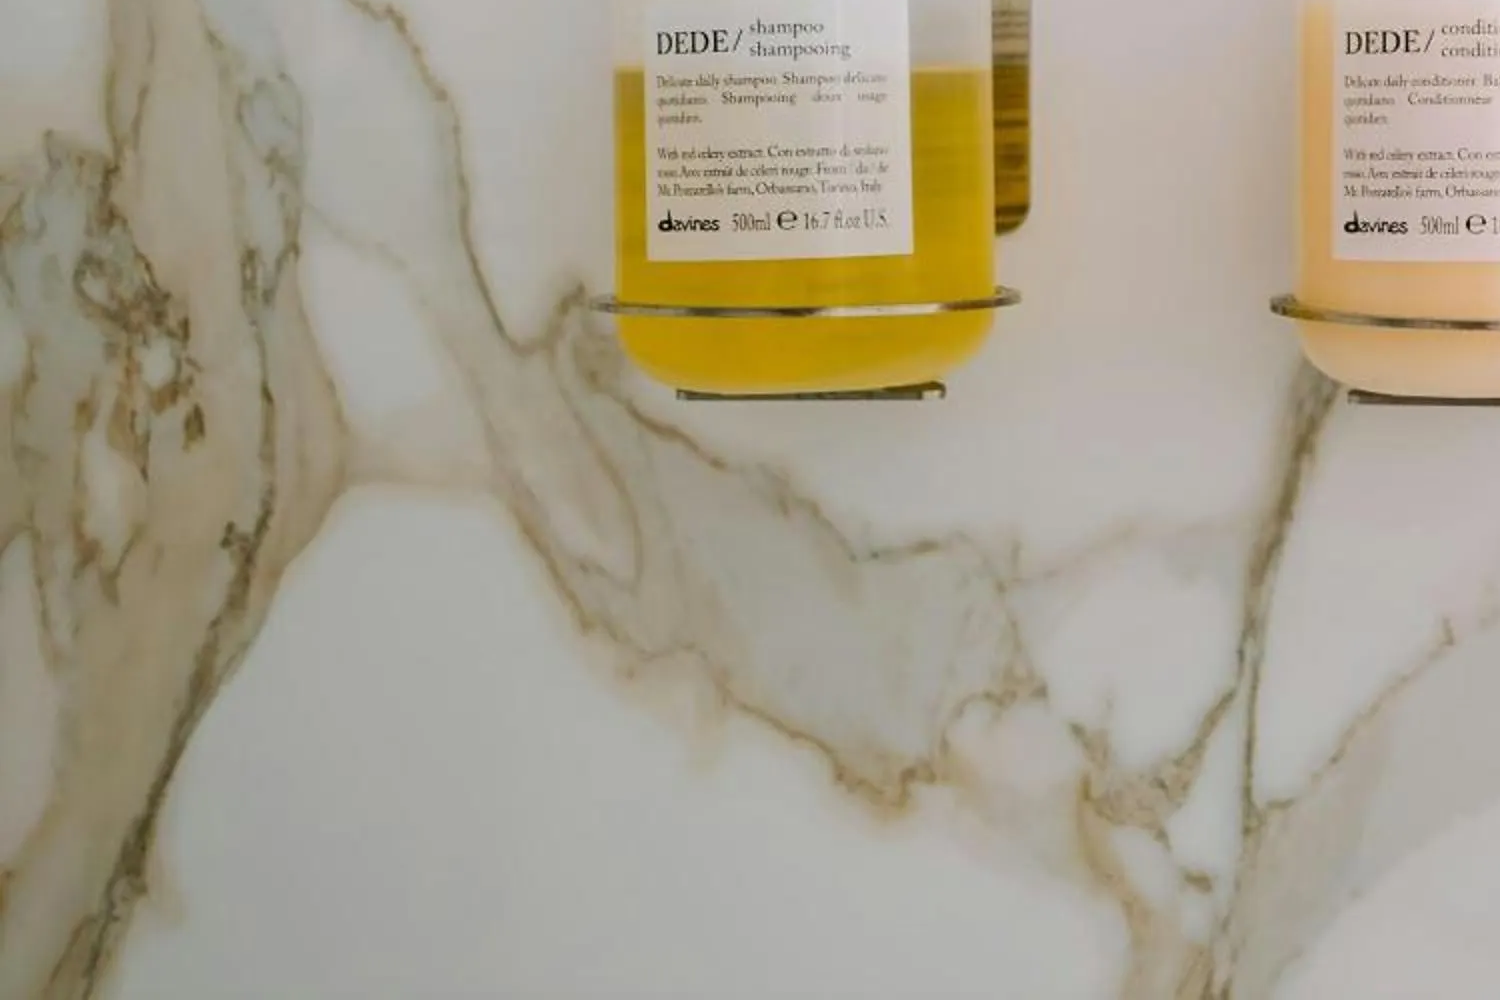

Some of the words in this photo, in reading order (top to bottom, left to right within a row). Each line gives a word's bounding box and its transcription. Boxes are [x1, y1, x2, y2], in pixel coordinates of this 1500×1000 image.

[749, 18, 824, 38] shampoo
[749, 41, 851, 61] shampooing
[767, 144, 793, 157] Con
[1457, 147, 1483, 161] Con
[658, 209, 720, 232] davines
[732, 212, 772, 232] 500ml
[1343, 209, 1408, 234] davines
[1420, 215, 1460, 235] 500ml
